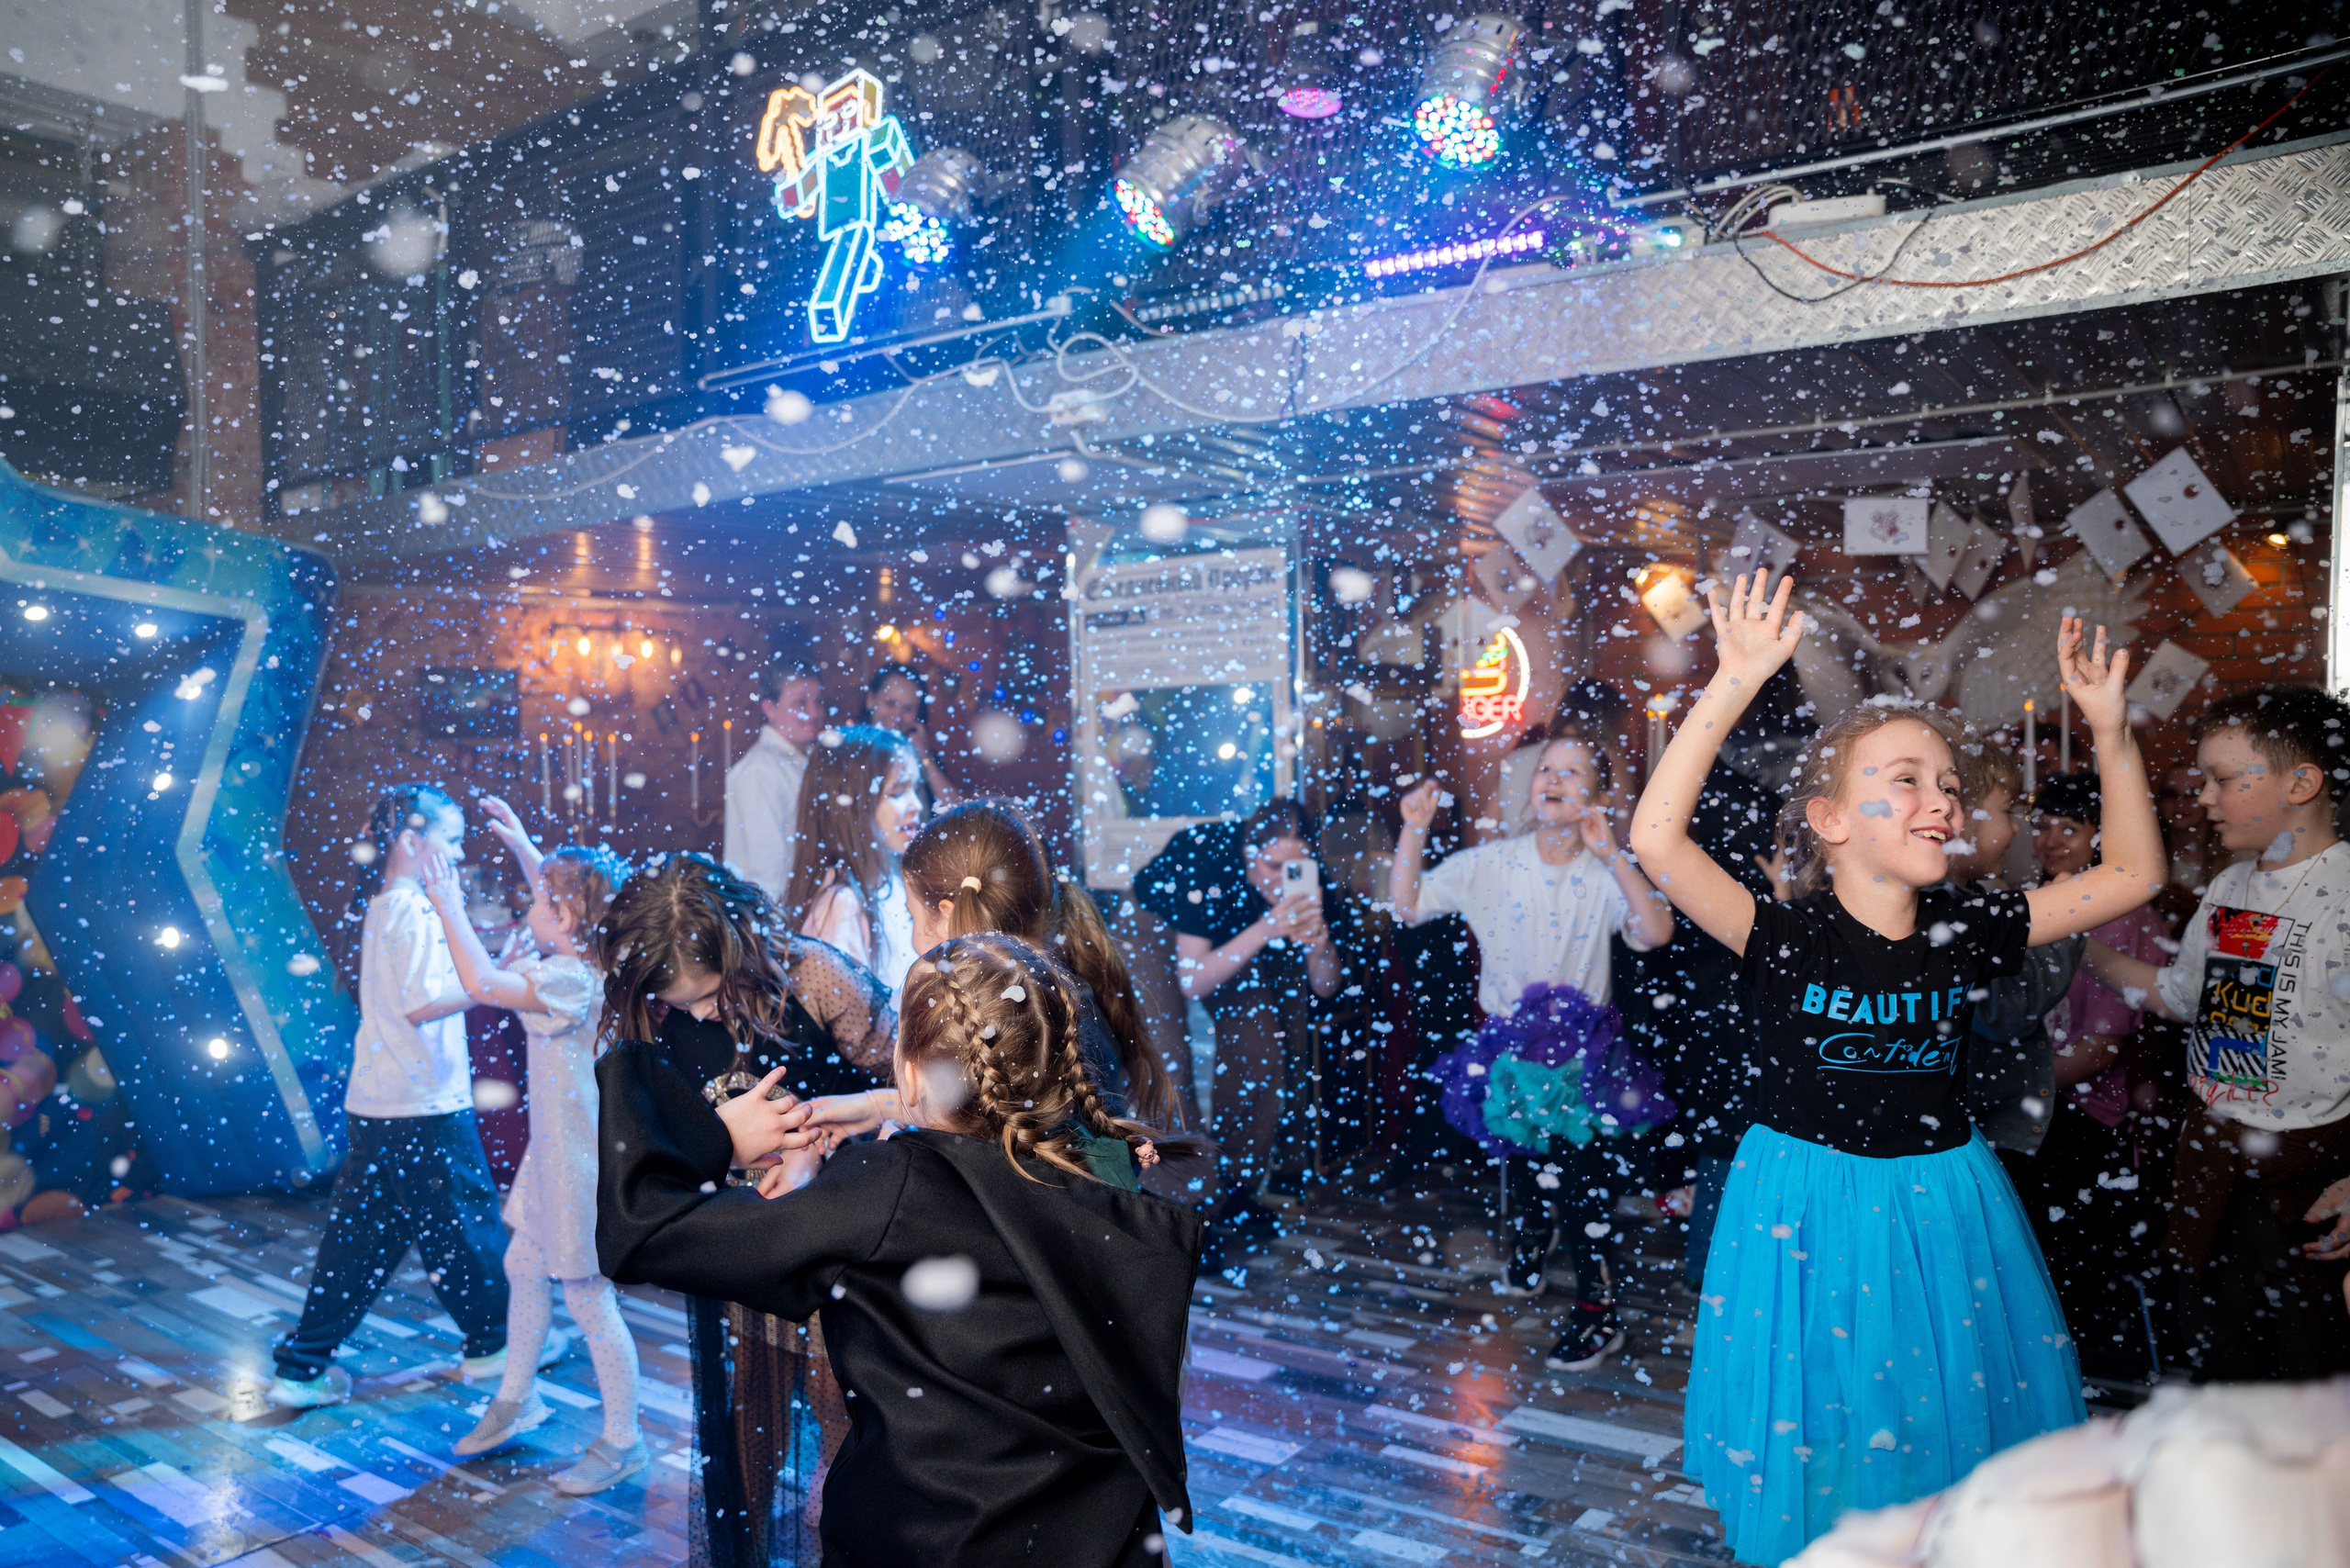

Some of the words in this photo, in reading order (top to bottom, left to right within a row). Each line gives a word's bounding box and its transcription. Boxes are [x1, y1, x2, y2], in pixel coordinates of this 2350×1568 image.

[2285, 922, 2313, 969] THIS
[2277, 972, 2297, 993] IS
[2274, 997, 2292, 1029] MY
[2271, 1030, 2288, 1081] JAM!
